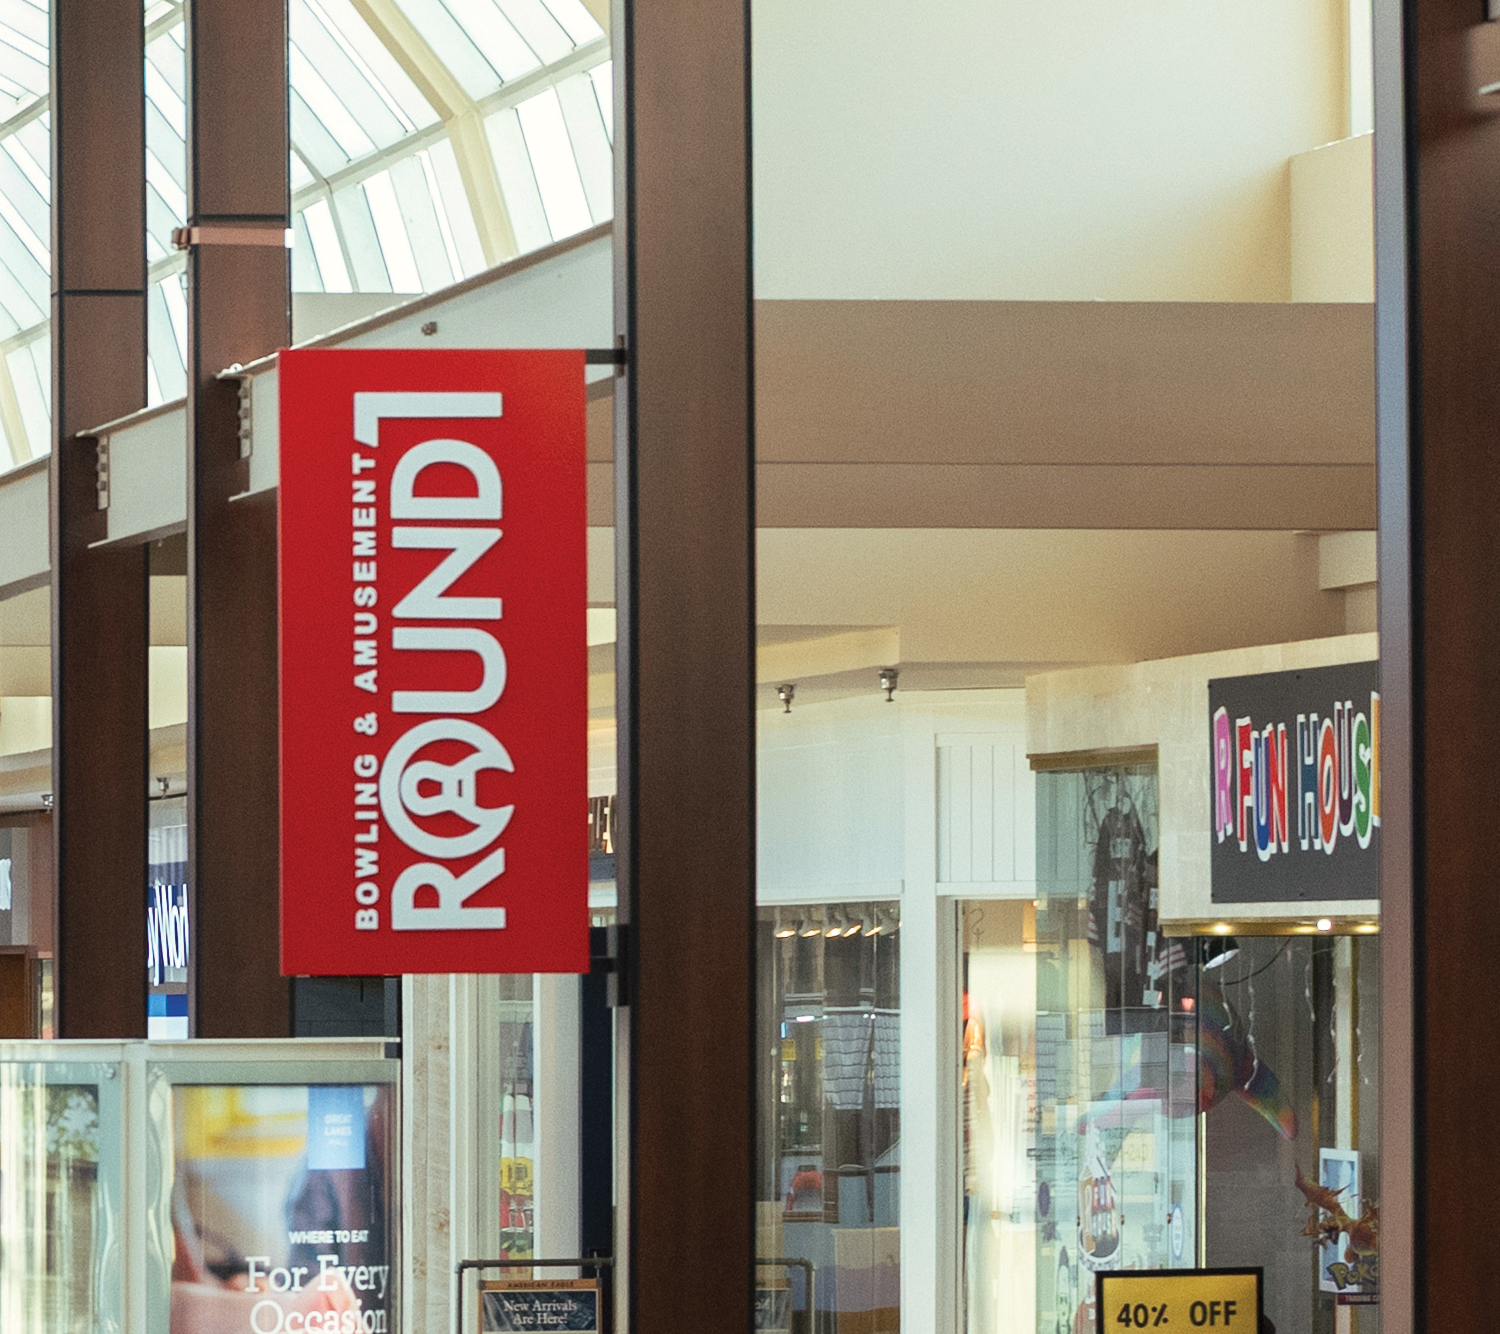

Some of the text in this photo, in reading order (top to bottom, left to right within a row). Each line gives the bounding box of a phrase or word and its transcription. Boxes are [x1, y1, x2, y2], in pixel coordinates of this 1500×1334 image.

[352, 451, 379, 930] BOWLING & AMUSEMENT
[1236, 715, 1289, 862] FUN
[289, 1229, 369, 1244] WHERE TO EAT
[245, 1254, 389, 1299] For Every
[503, 1299, 578, 1313] New Arrivals
[512, 1312, 568, 1325] Are Here!
[1116, 1300, 1237, 1328] 40% OFF
